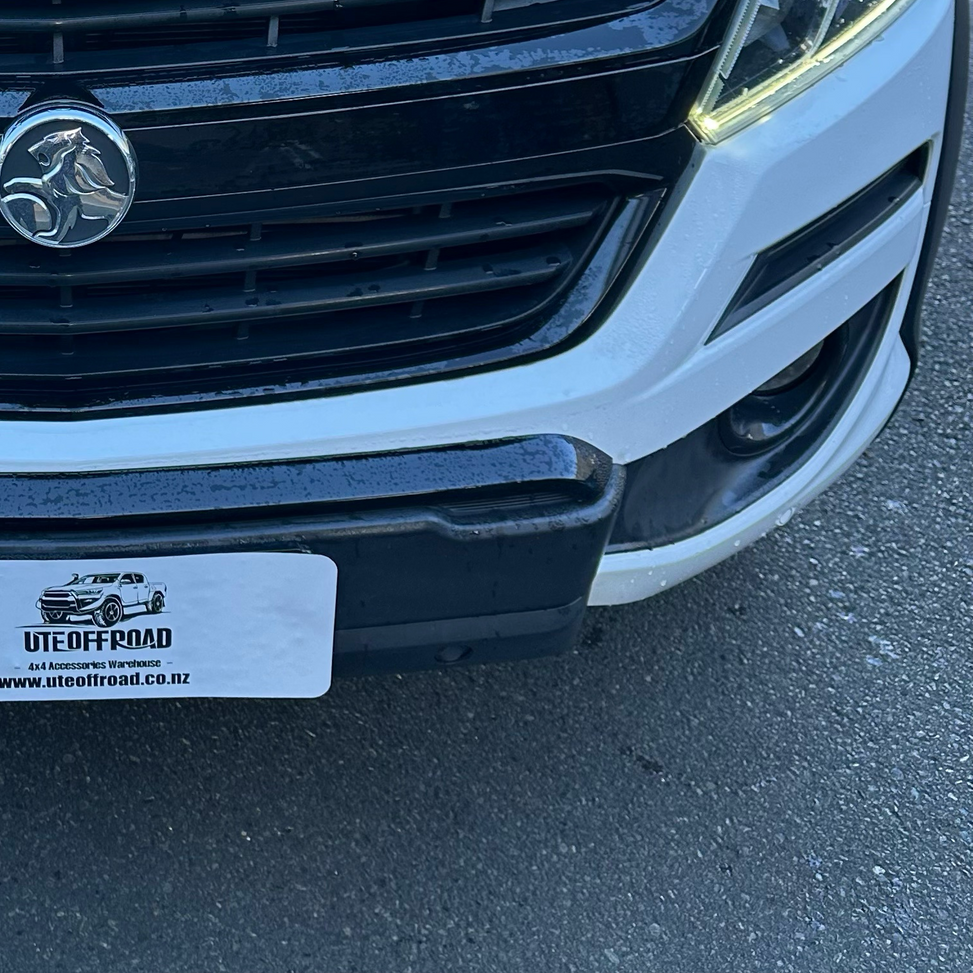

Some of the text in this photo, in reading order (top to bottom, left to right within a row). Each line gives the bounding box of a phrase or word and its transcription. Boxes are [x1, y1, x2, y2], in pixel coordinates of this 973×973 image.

[24, 628, 173, 653] UTEOFFROAD
[28, 659, 162, 671] 4x4 Accessories Warehouse
